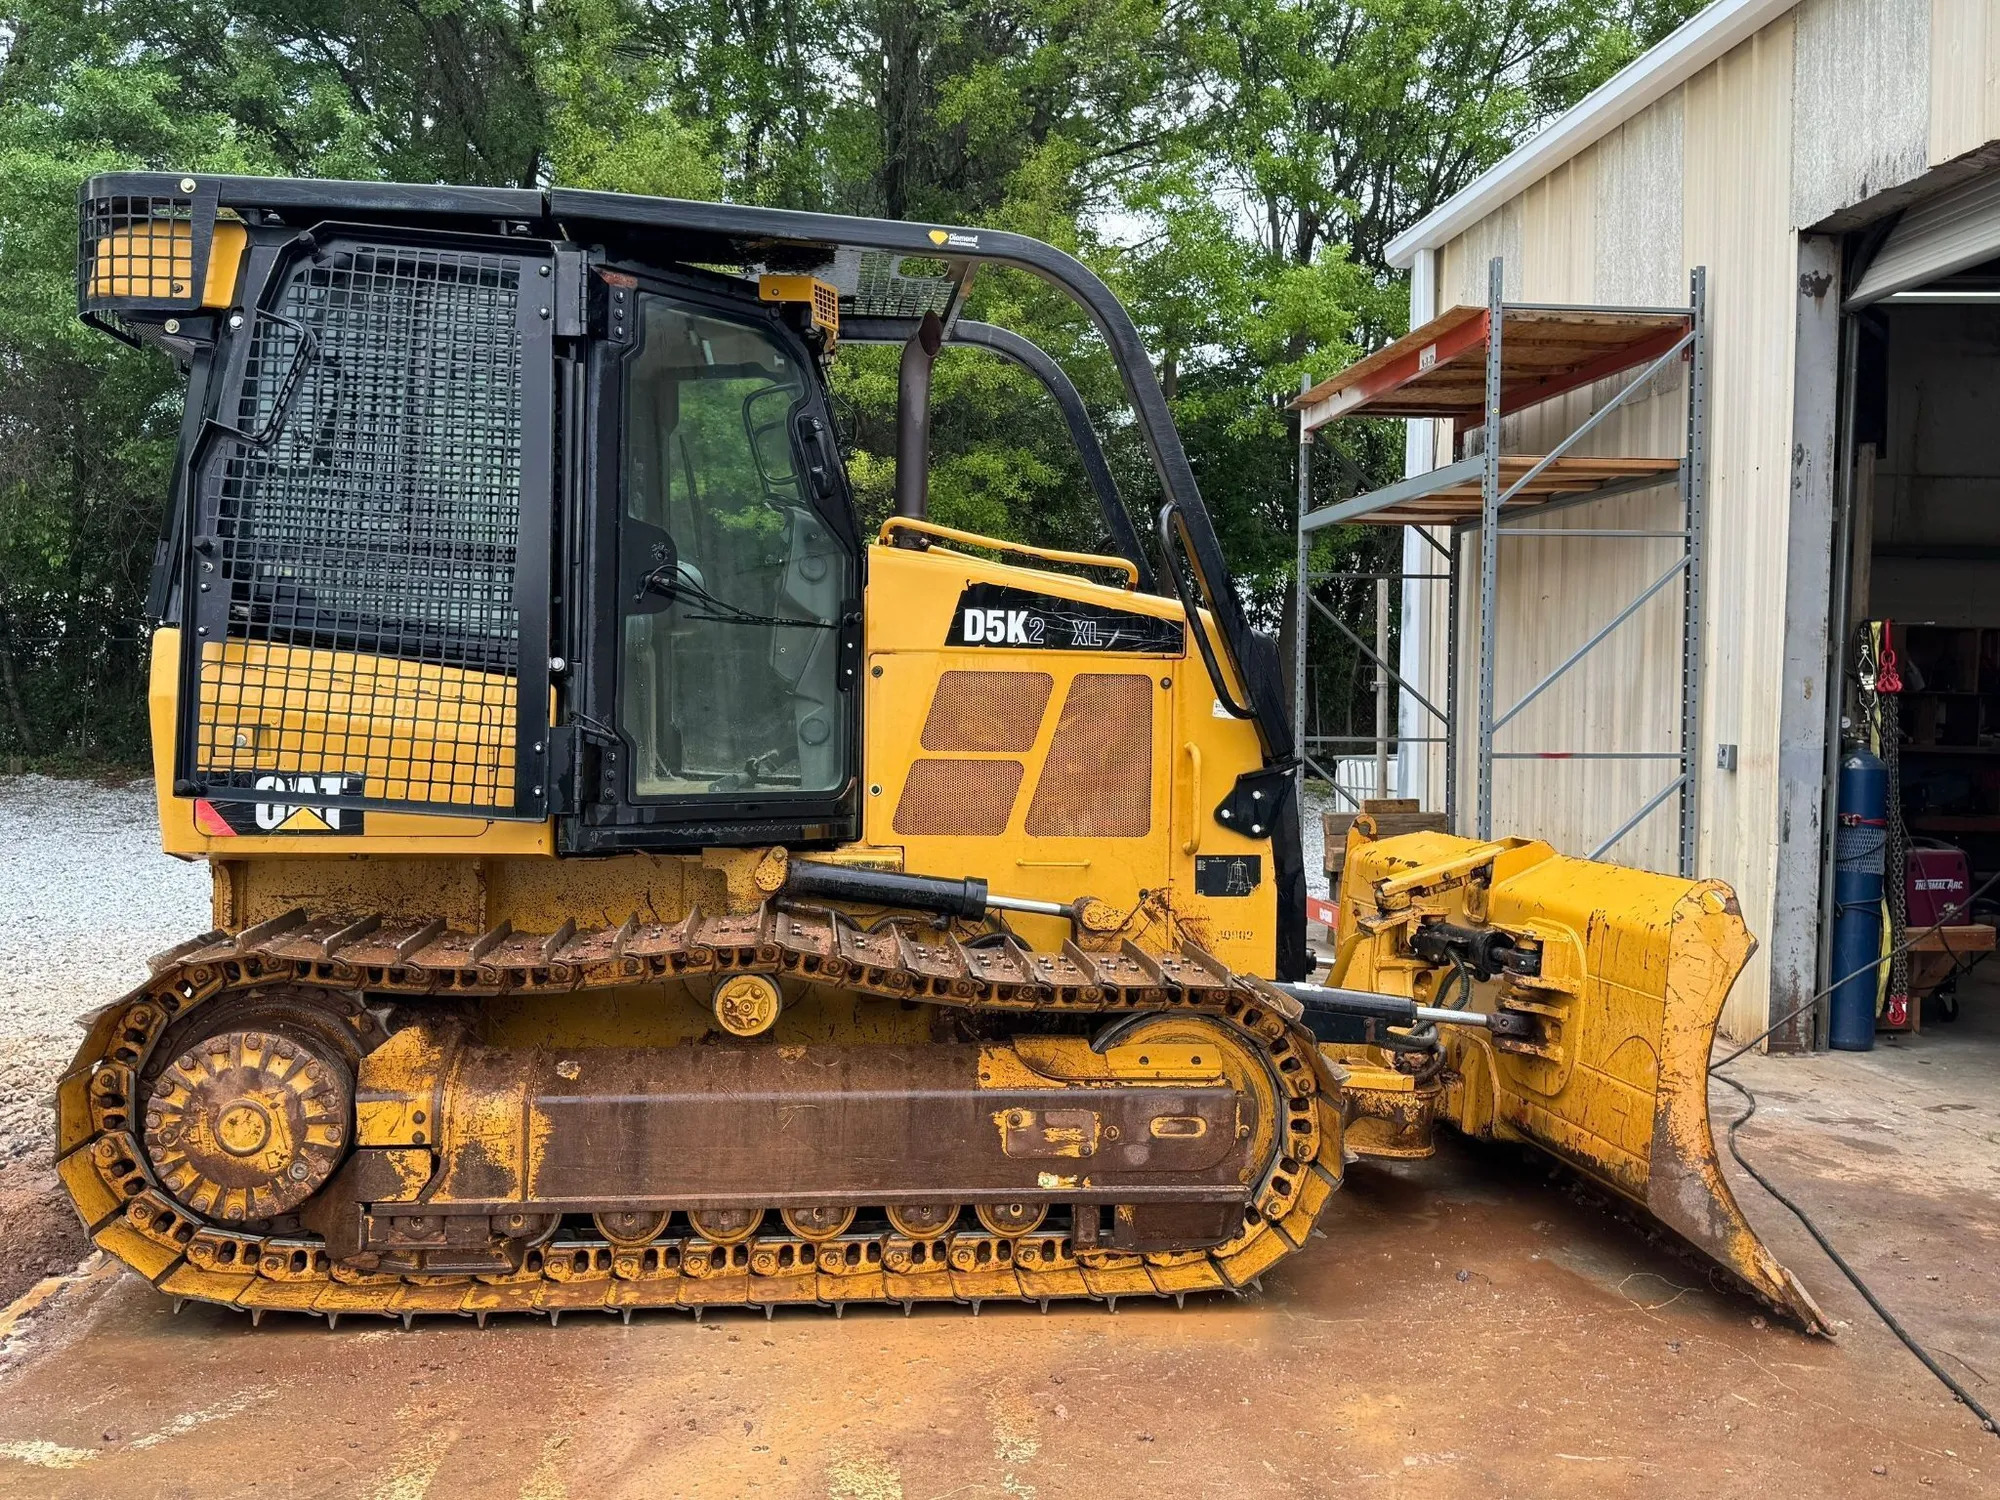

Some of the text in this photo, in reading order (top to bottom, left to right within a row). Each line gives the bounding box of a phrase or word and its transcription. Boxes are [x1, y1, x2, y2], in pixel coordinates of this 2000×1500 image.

[949, 233, 978, 243] Diamond
[1071, 620, 1103, 646] XL
[255, 776, 347, 830] CAT
[1947, 879, 1963, 891] ARC
